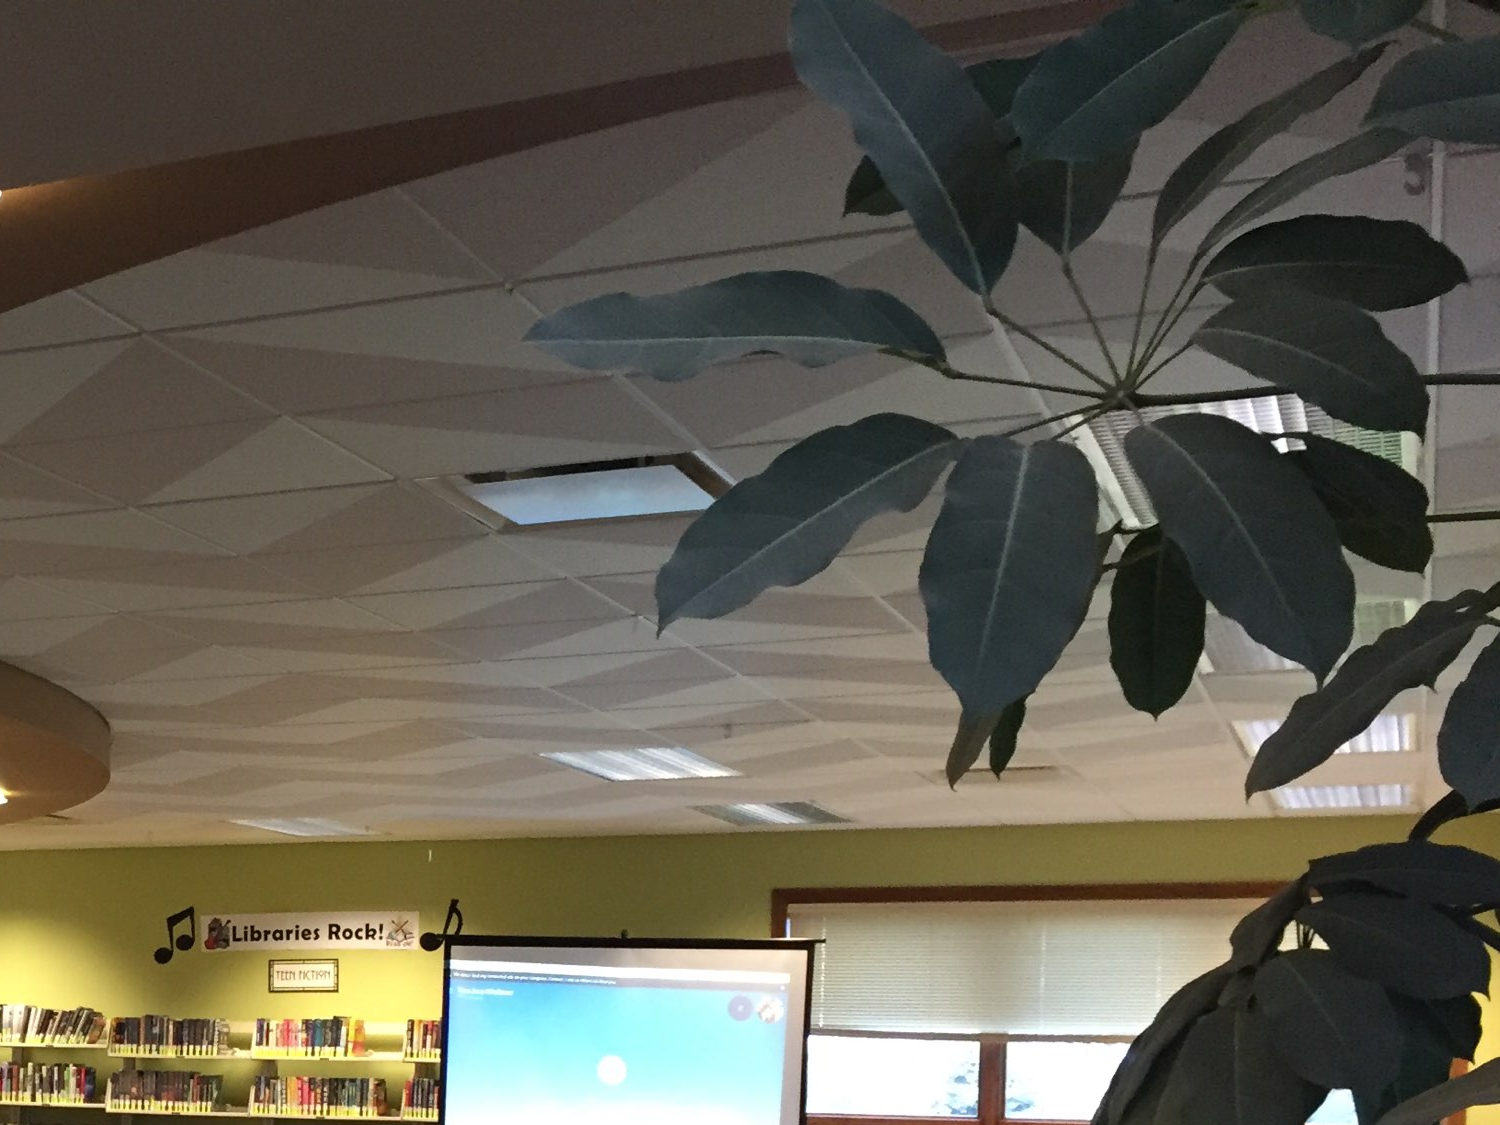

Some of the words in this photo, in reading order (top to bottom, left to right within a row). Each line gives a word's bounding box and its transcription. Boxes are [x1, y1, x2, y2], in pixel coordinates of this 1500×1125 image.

[231, 924, 320, 942] Libraries
[328, 923, 384, 941] Rock!
[275, 969, 296, 981] TEEN
[299, 969, 331, 981] FICTION
